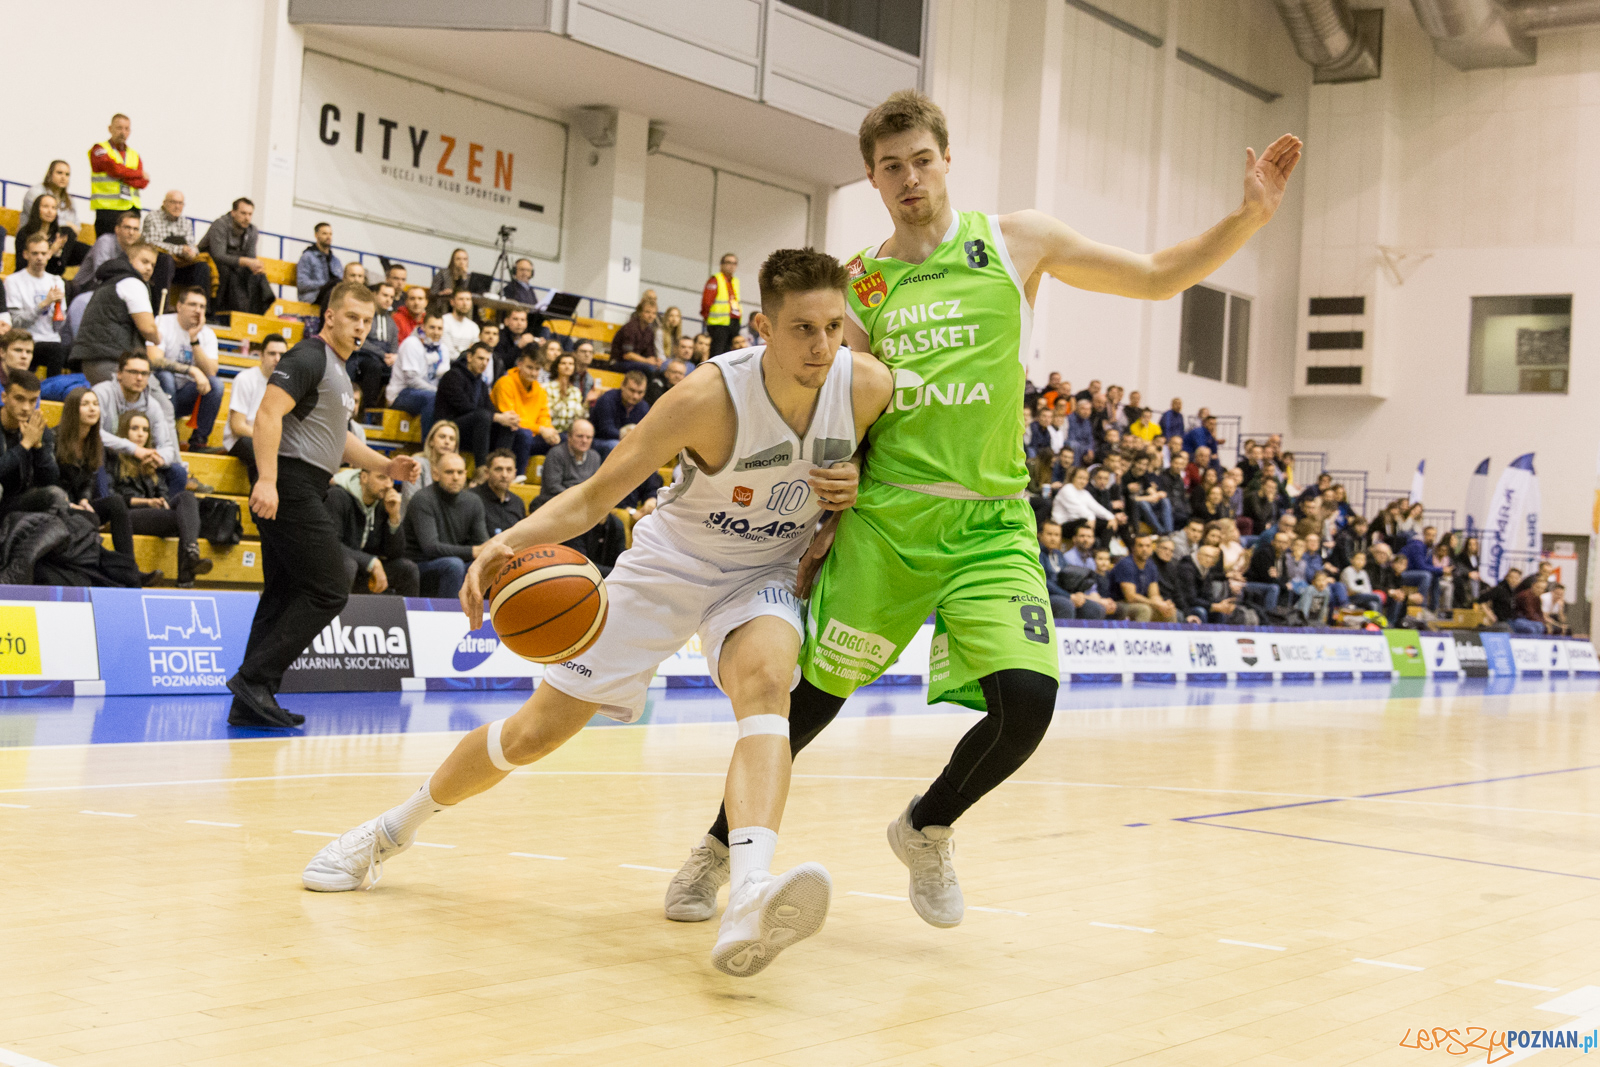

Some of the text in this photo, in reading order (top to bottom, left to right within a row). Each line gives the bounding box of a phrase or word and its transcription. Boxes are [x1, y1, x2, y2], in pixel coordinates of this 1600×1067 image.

[319, 103, 514, 191] CITYZEN
[438, 179, 460, 193] KLUB
[465, 185, 512, 204] SPORTOWY
[964, 239, 989, 269] 8
[883, 299, 963, 333] ZNICZ
[881, 324, 980, 359] BASKET
[766, 479, 811, 516] 10
[1020, 604, 1049, 644] 8
[458, 634, 498, 654] atrem
[150, 649, 225, 673] HOTEL
[288, 654, 410, 670] UKARNIA SKOCZYŃSKI
[152, 673, 227, 687] POZNAŃSKI
